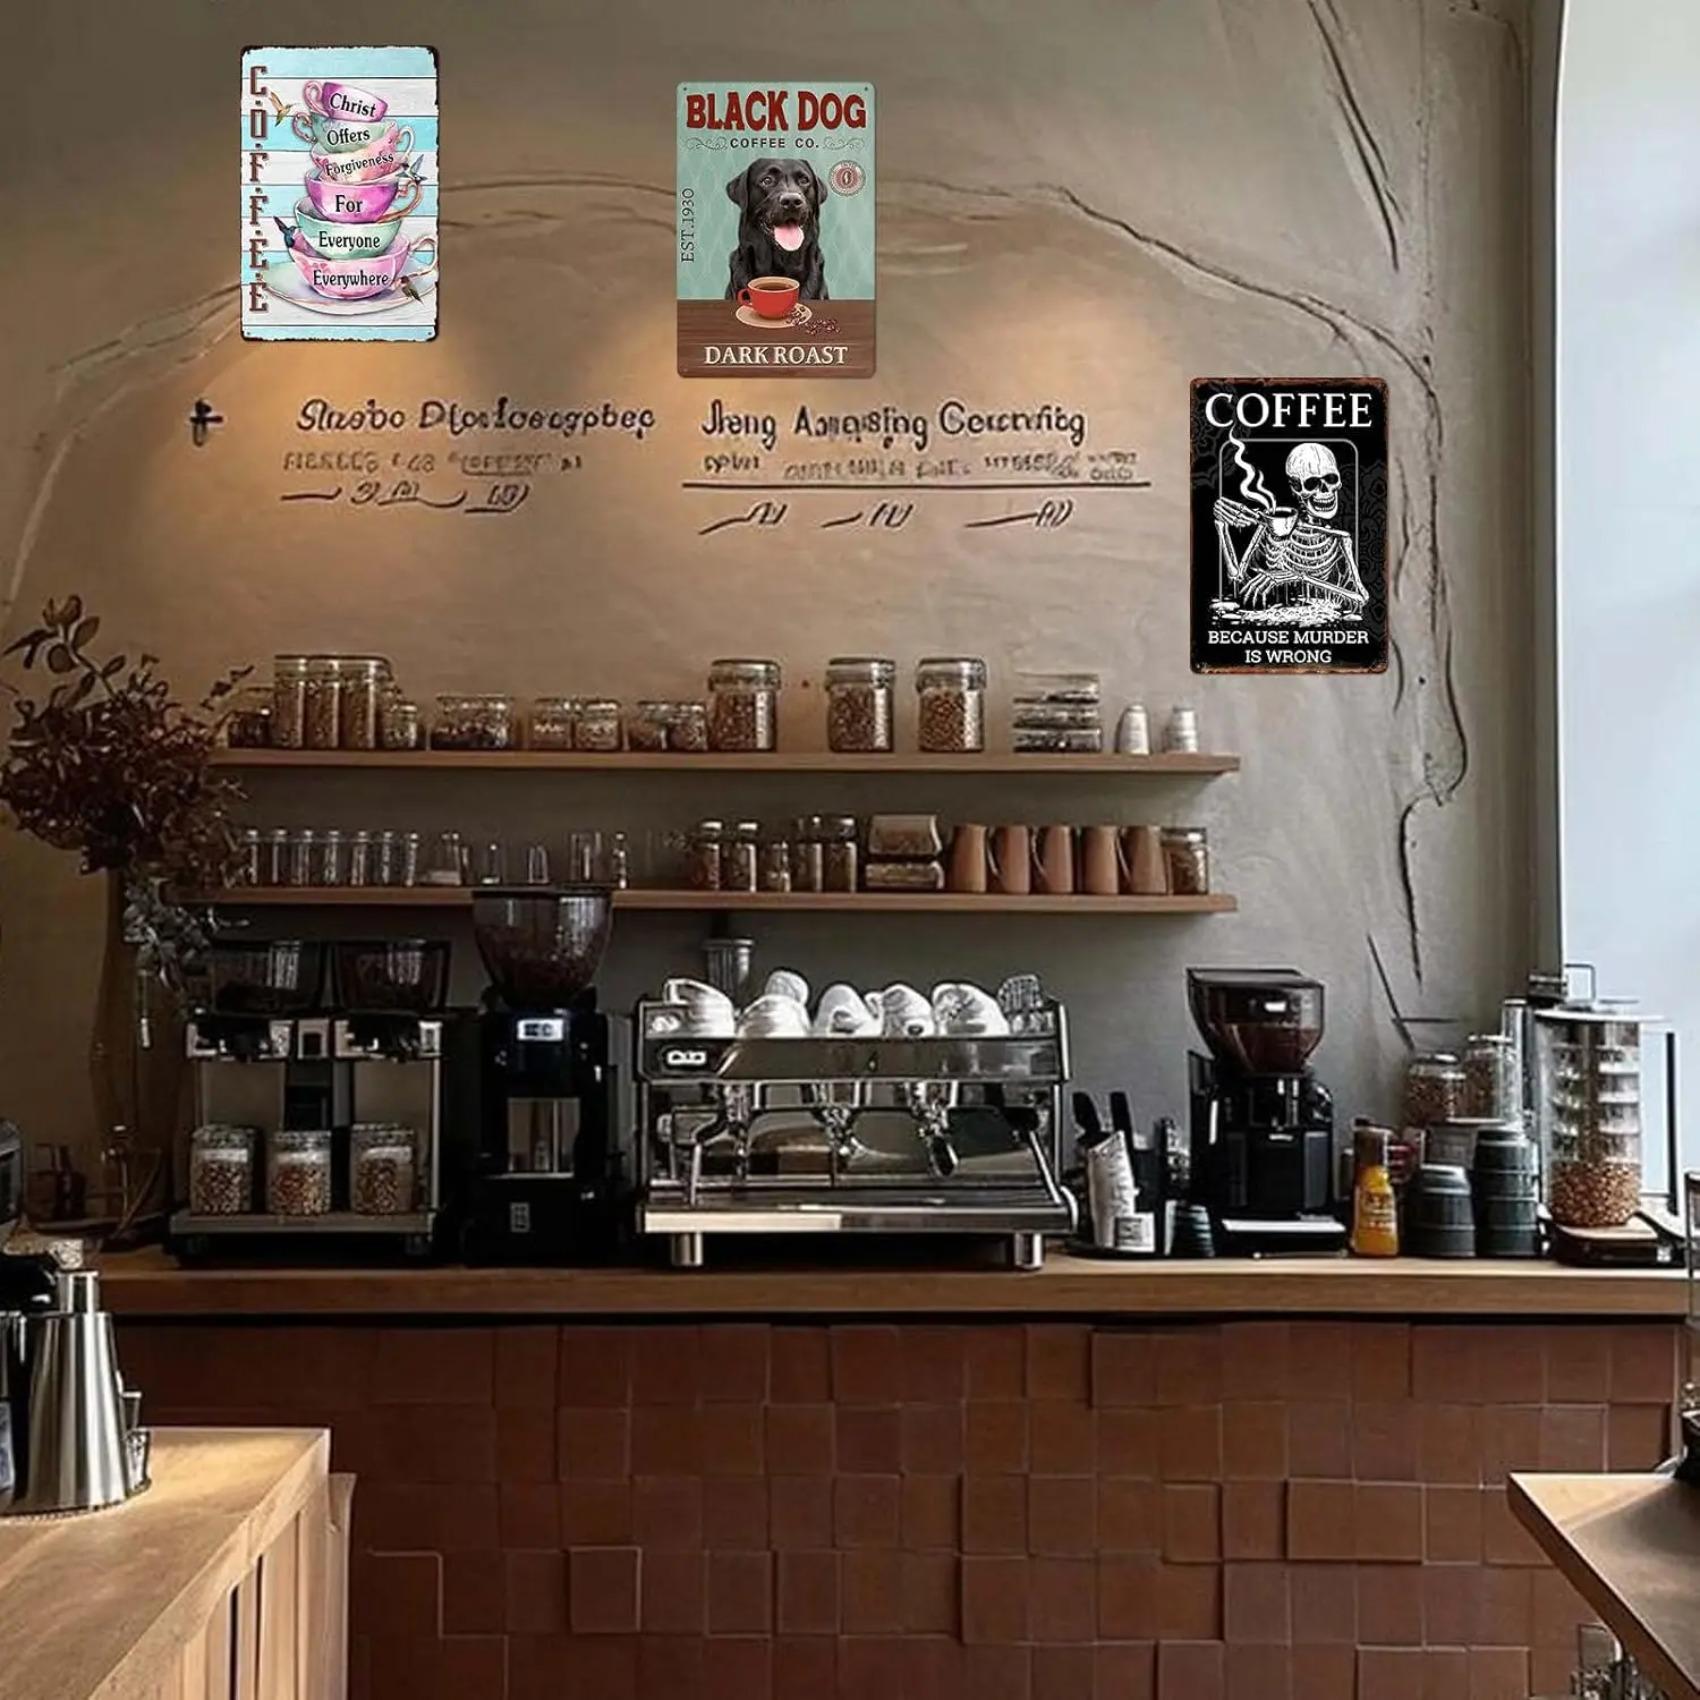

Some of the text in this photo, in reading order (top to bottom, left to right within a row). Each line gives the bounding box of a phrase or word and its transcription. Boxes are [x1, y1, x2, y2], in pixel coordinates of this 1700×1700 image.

[329, 93, 377, 117] Christ
[686, 91, 867, 131] BLACK DOG
[327, 129, 371, 146] Offers
[730, 138, 819, 149] COFFEE CO.
[326, 153, 394, 177] Forgiveness
[335, 195, 363, 213] For
[318, 230, 381, 250] Everyone
[312, 269, 389, 289] Everywhere
[704, 346, 848, 365] DARK ROAST
[1205, 393, 1373, 428] COFFEE
[1208, 631, 1369, 645] BECAUSE MURDER
[1246, 651, 1332, 664] IS WRONG
